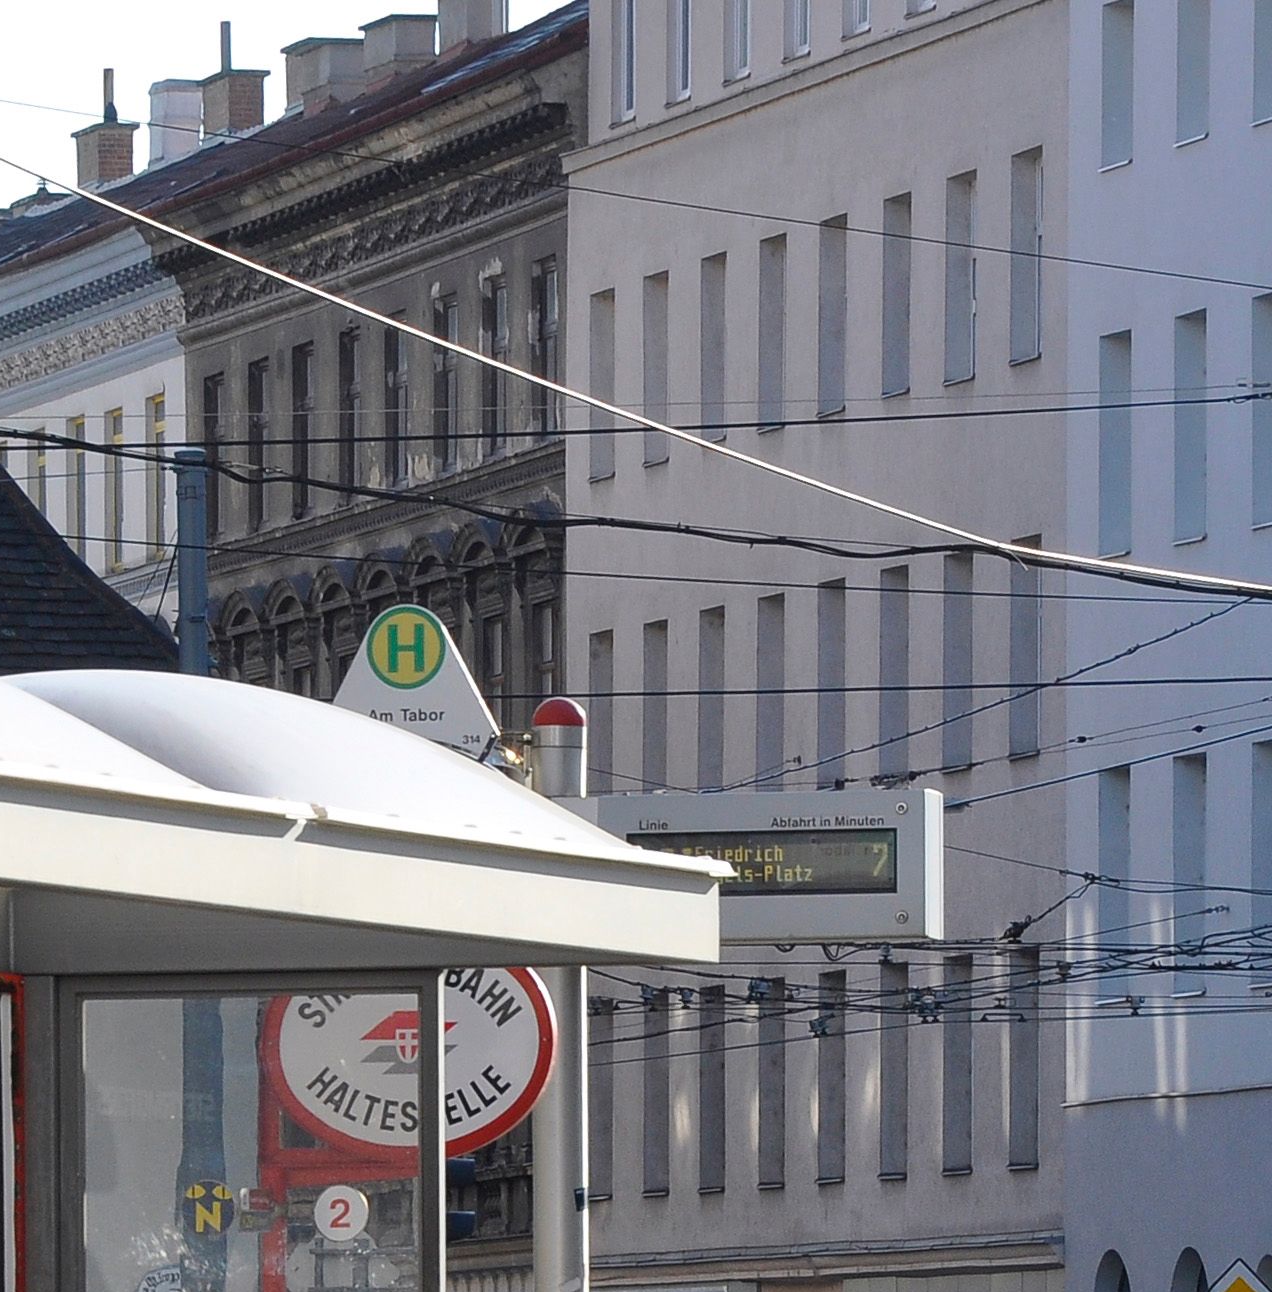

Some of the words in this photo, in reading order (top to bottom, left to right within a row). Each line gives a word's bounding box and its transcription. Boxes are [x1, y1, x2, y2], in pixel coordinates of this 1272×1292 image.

[387, 623, 425, 673] H
[369, 709, 393, 722] Am
[400, 708, 446, 722] Tabor
[462, 734, 481, 745] 314
[638, 819, 669, 831] Linie
[770, 816, 818, 829] Abfahrt
[819, 816, 830, 828] in
[833, 815, 885, 828] Minuten
[872, 843, 889, 877] 7
[305, 1064, 513, 1133] HALTESELLE
[195, 1201, 222, 1233] N
[328, 1198, 352, 1229] 2
